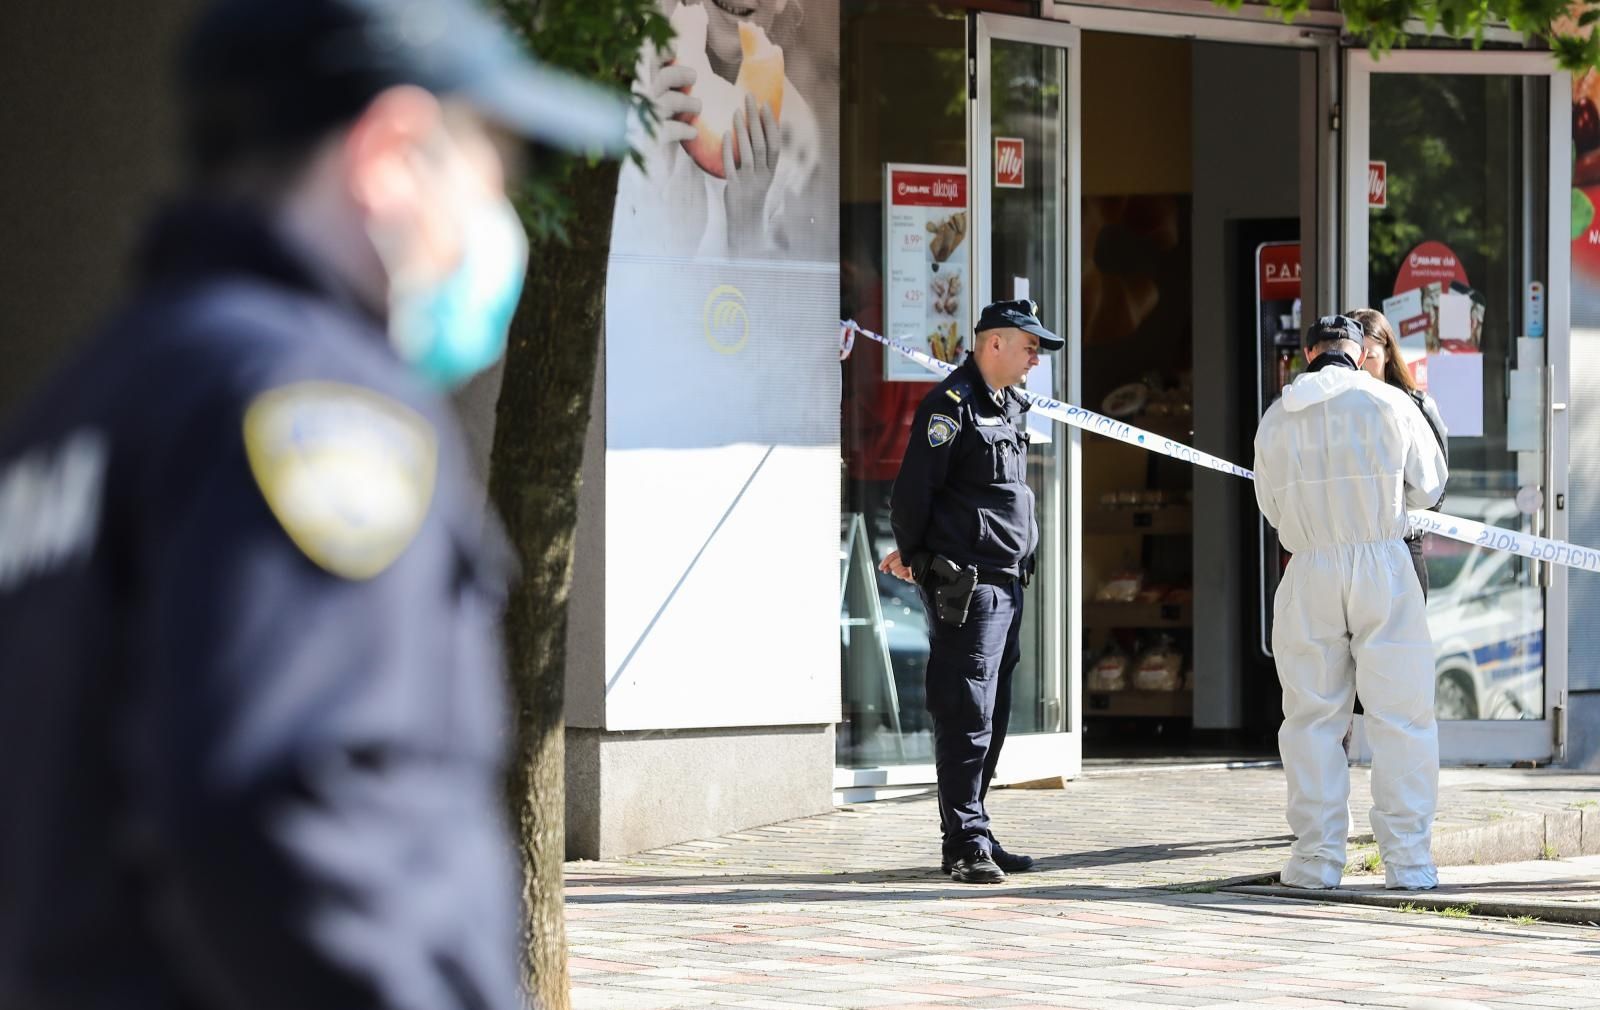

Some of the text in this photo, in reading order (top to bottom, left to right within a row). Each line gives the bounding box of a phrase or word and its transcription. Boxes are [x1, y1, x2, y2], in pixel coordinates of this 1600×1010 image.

[999, 146, 1021, 180] illy
[933, 179, 958, 201] akcija
[1369, 168, 1384, 201] lly
[1589, 229, 1600, 244] N
